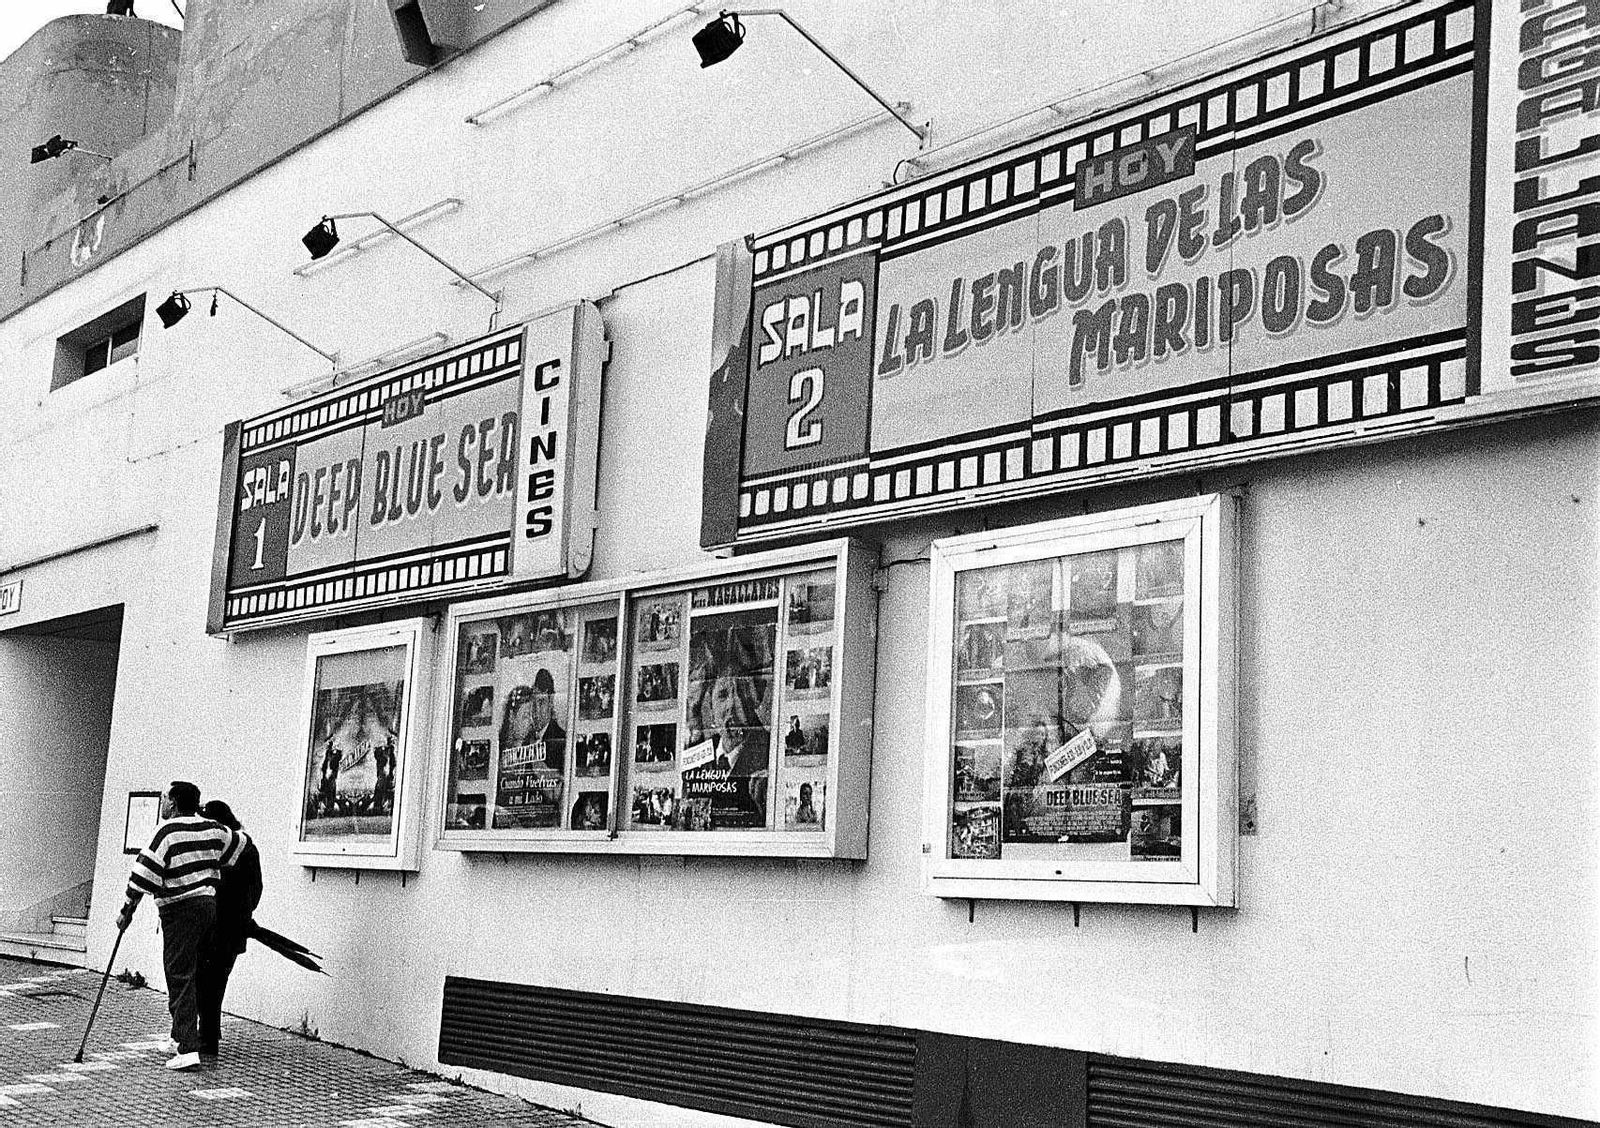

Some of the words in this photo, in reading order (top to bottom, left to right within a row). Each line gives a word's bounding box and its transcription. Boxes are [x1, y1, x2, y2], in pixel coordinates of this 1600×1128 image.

[1084, 136, 1188, 201] HOY
[1510, 0, 1600, 376] AGALLANES
[877, 298, 938, 377] LA
[943, 217, 1127, 354] LENGUA
[1145, 185, 1209, 277] DE
[1212, 139, 1324, 247] LAS
[759, 280, 864, 367] SALA
[1068, 213, 1452, 388] MARIPOSAS
[383, 391, 424, 425] HOY
[785, 367, 824, 449] 2
[292, 458, 361, 546] DEEP
[370, 432, 446, 526] BLUE
[453, 411, 518, 503] SEA
[525, 358, 561, 538] CINES
[241, 460, 290, 511] SALA
[251, 517, 265, 570] 1
[0, 586, 15, 610] OY
[692, 781, 737, 793] MARIPOSAS
[1046, 790, 1071, 807] DEEP
[1072, 789, 1100, 806] BLUE
